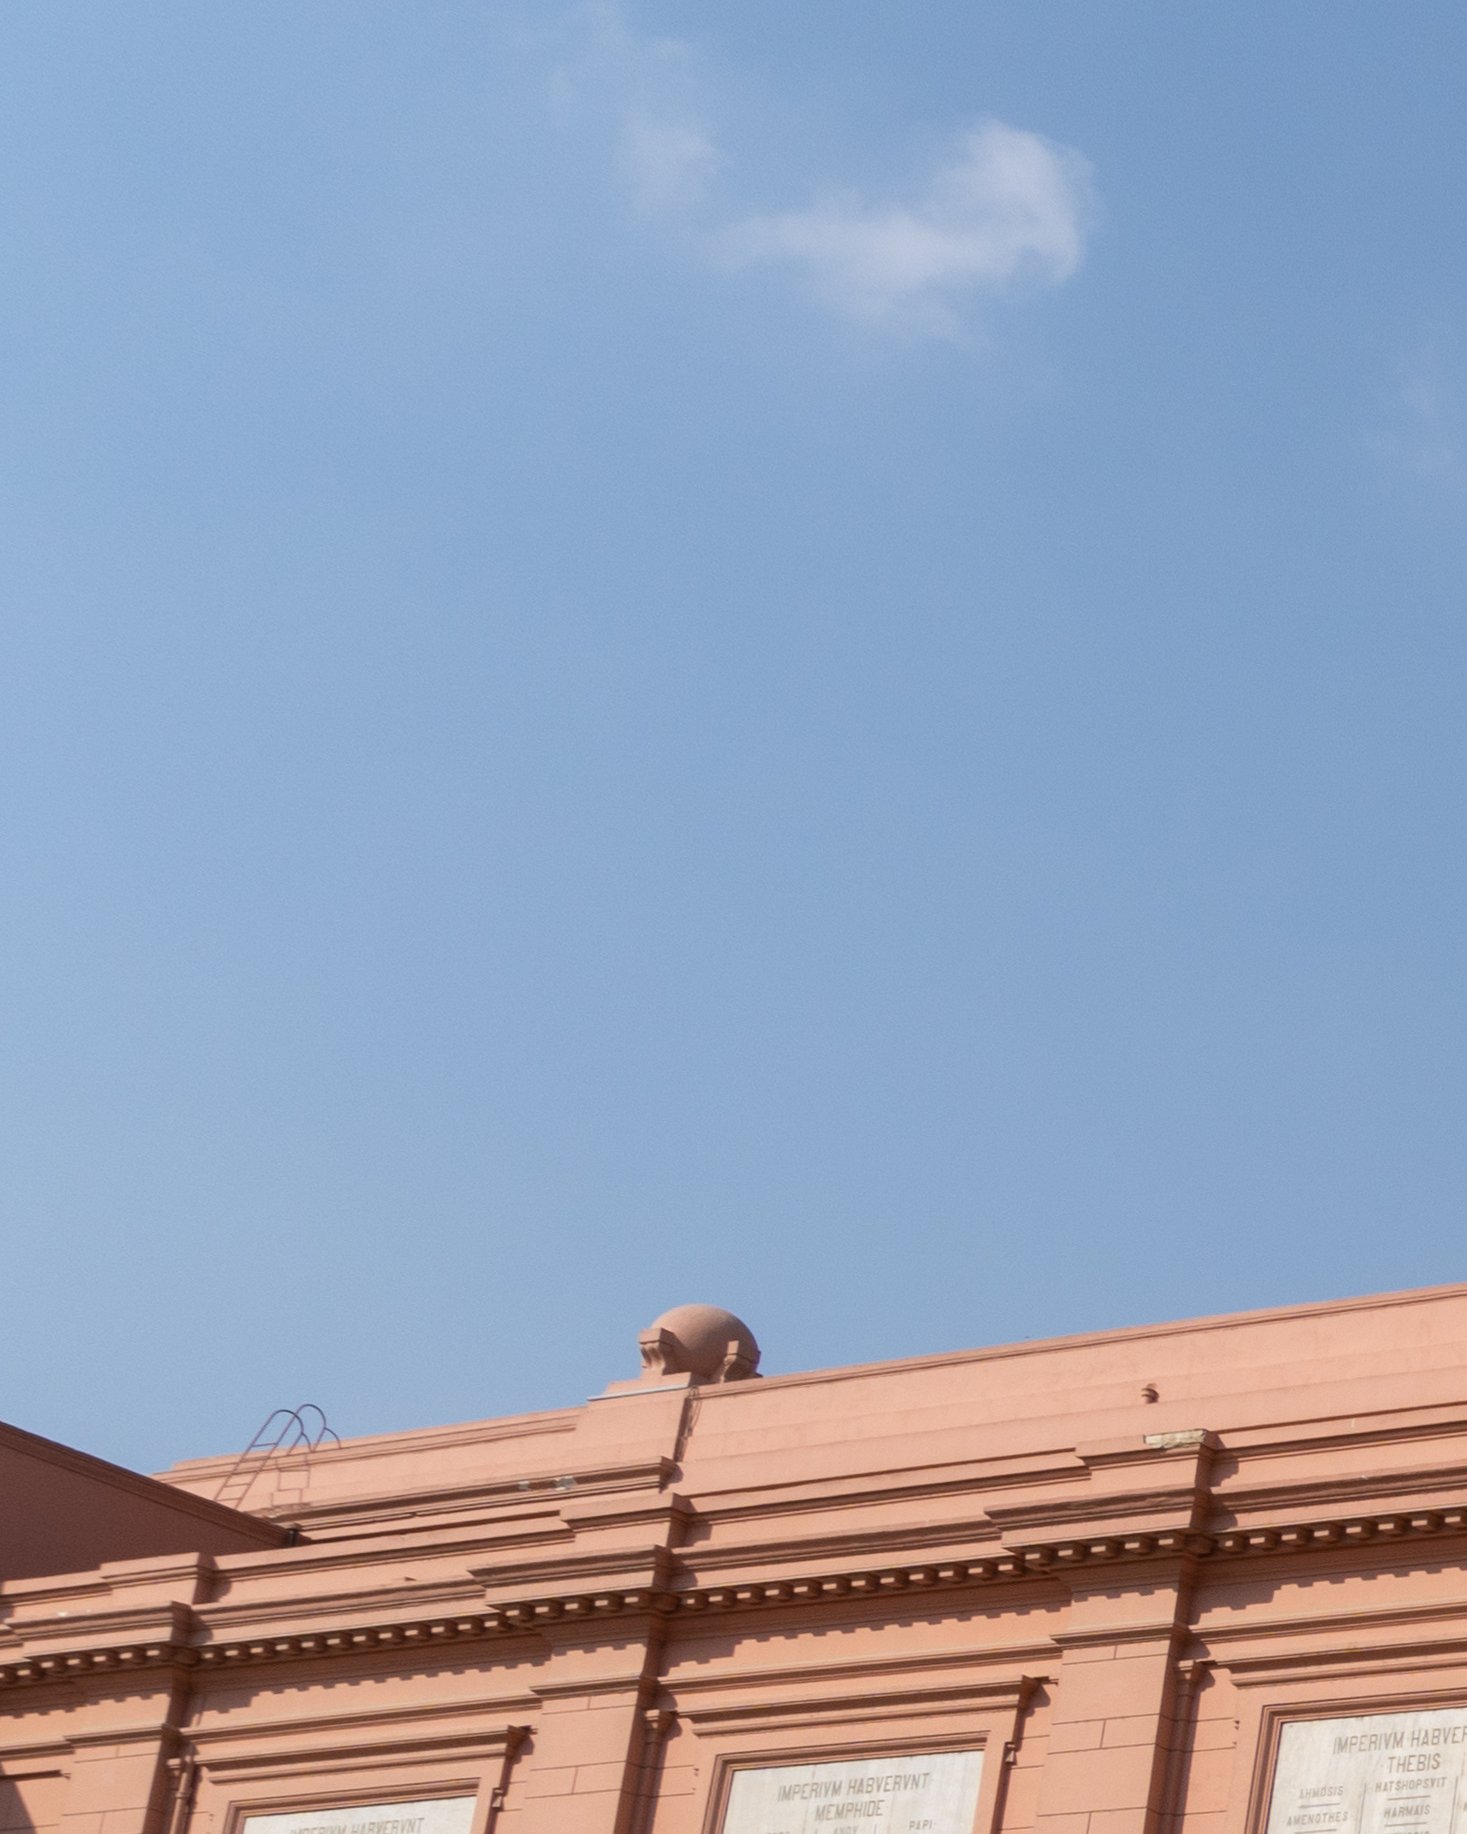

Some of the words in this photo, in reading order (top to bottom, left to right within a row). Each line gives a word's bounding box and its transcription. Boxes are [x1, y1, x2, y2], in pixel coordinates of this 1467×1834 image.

[1333, 1731, 1404, 1755] IMPERIVM
[1387, 1753, 1441, 1774] THEBIS
[777, 1778, 842, 1802] IMPERIVM
[846, 1772, 931, 1797] HABVERVNT
[814, 1800, 886, 1822] MEMPHIDE
